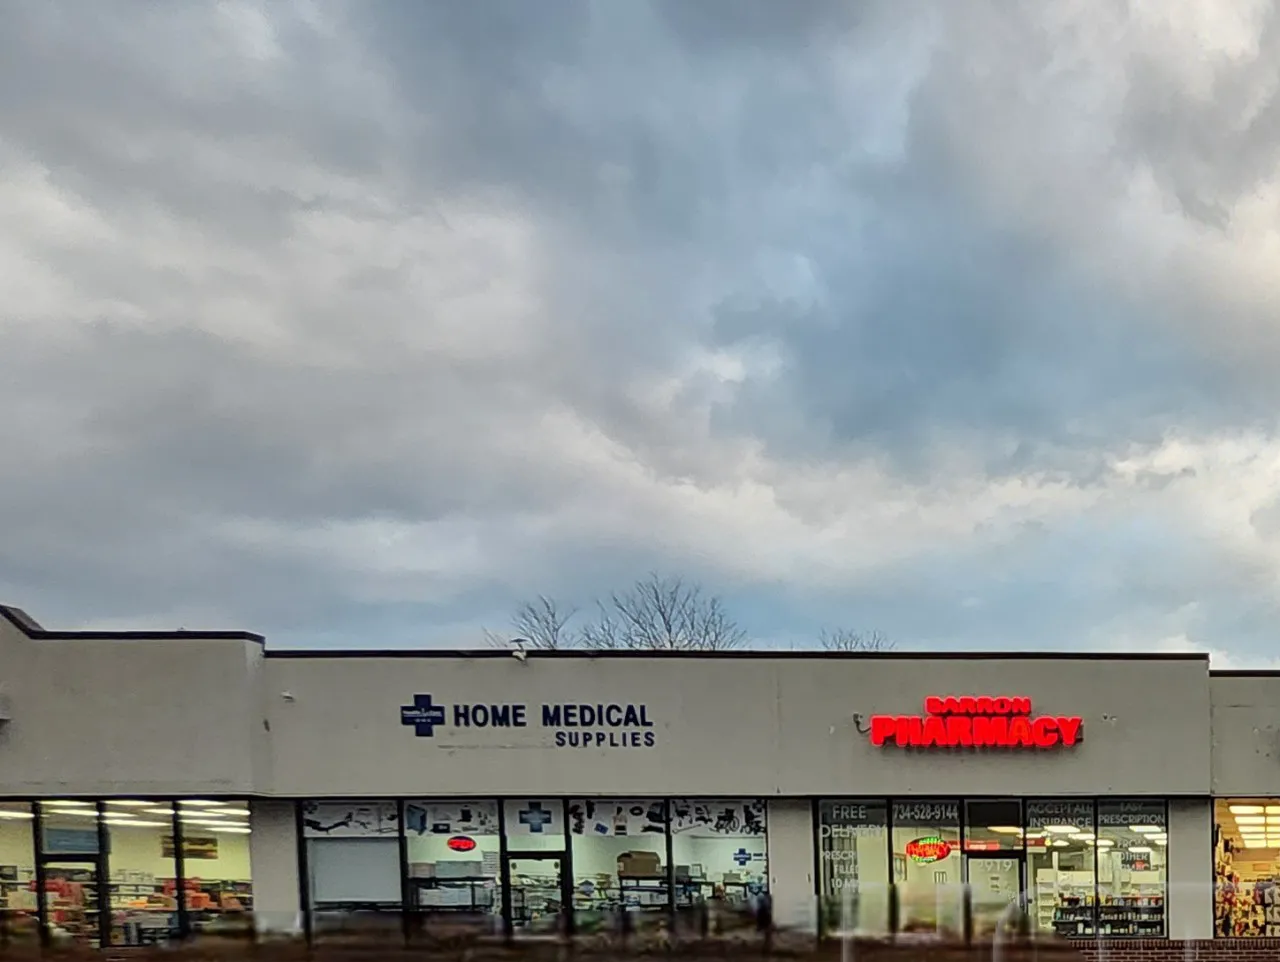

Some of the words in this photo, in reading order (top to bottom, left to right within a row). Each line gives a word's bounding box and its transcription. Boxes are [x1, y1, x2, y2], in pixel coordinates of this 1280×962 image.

[925, 697, 1031, 714] BARRON
[453, 704, 527, 727] HOME
[542, 704, 654, 727] MEDICAL
[870, 716, 1082, 746] PHARMACY
[556, 732, 656, 747] SUPPLIES
[832, 805, 866, 819] FREE
[893, 804, 958, 820] 734-528-9144
[1098, 814, 1165, 825] PRESCRIPTION
[1029, 817, 1092, 828] INSURANCE
